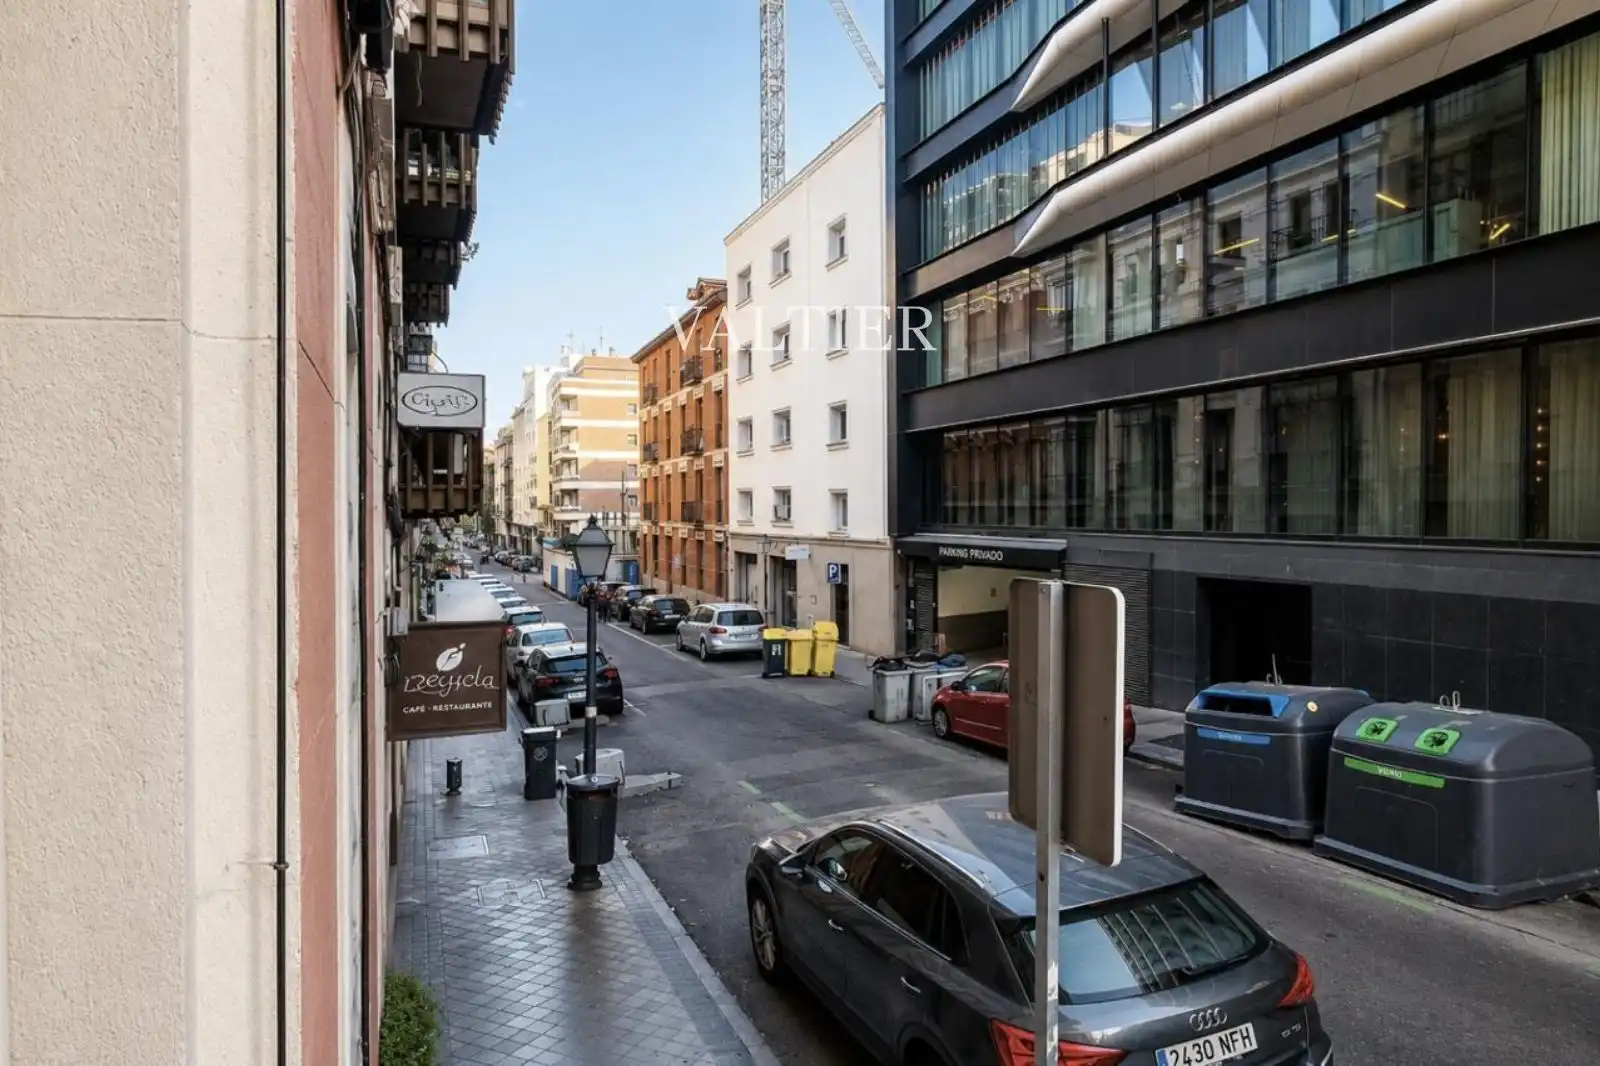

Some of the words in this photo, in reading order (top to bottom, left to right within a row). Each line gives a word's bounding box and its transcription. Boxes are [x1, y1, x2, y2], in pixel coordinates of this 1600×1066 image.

[938, 546, 968, 559] PARKING
[969, 548, 1004, 561] PRIVADO
[829, 564, 837, 577] P
[403, 665, 500, 698] Recycla
[433, 701, 493, 712] RESTAURANTE
[1170, 1039, 1214, 1066] 2430
[1218, 1027, 1253, 1056] NFH
